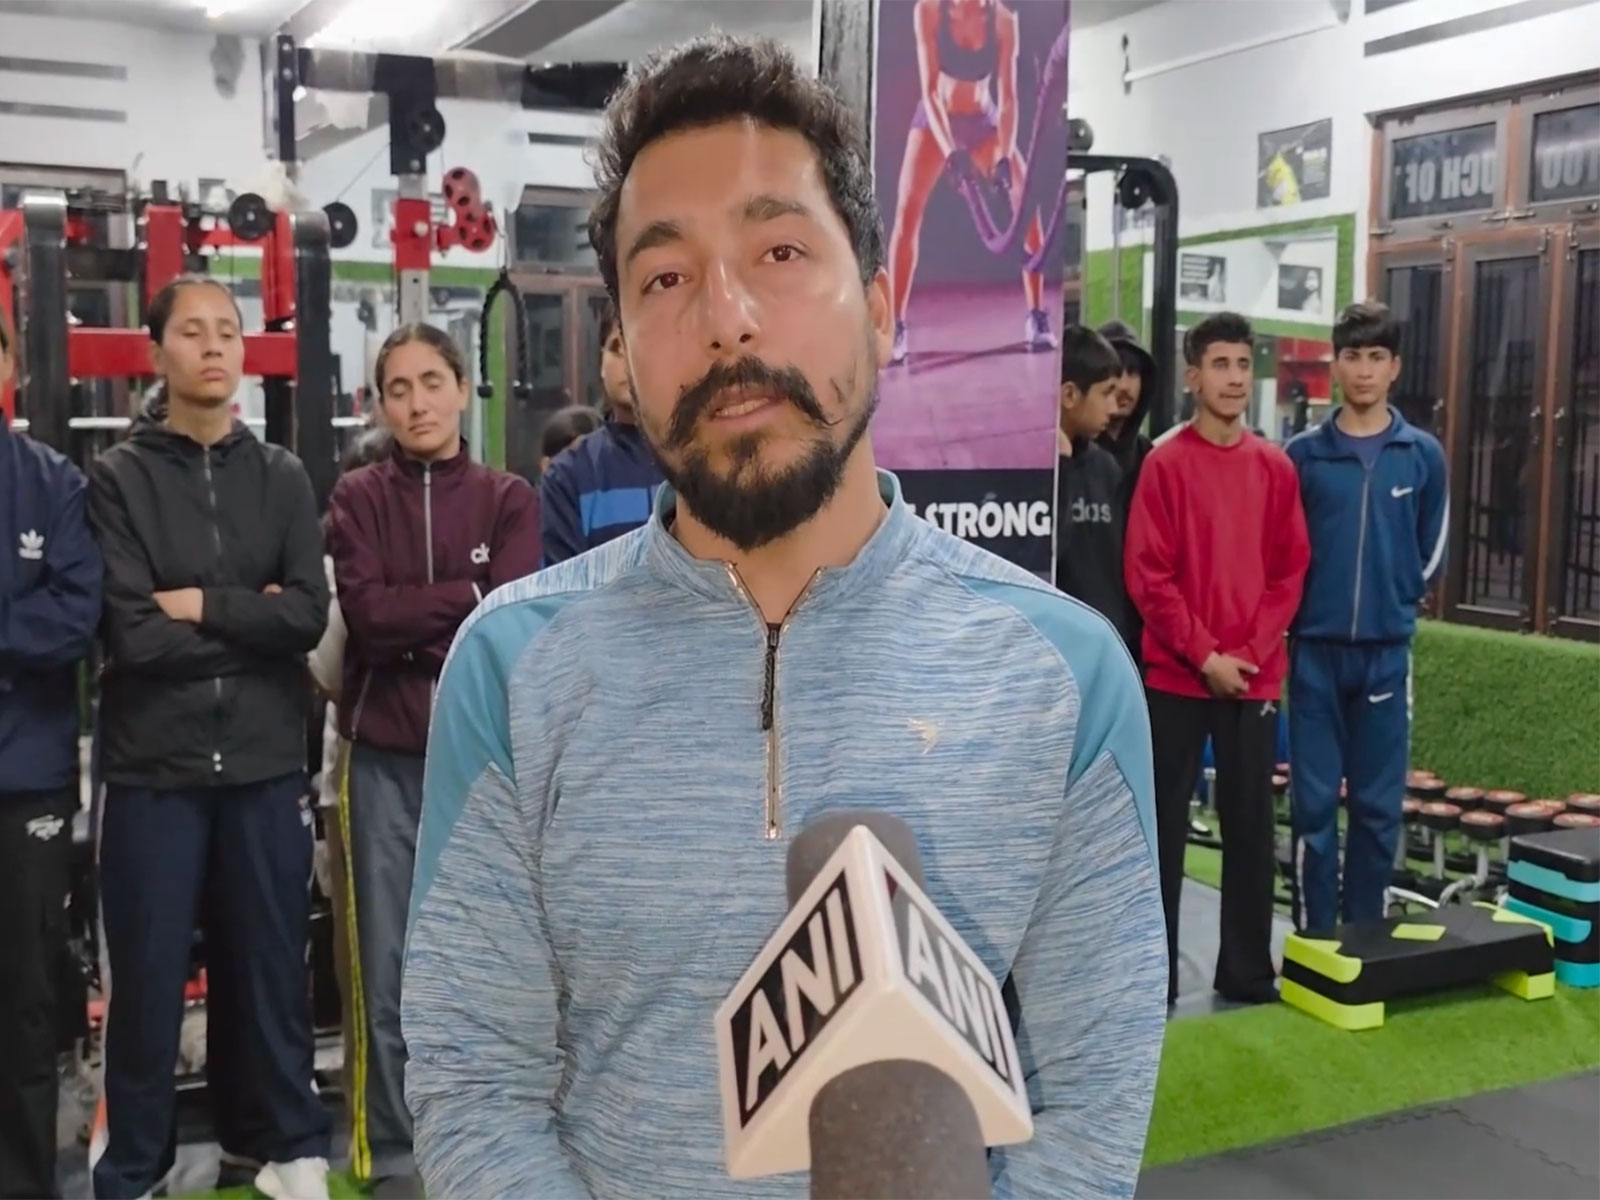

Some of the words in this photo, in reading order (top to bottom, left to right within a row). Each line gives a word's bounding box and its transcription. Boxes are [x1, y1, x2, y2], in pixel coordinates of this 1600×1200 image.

[924, 501, 1051, 538] STRONG
[745, 886, 855, 1112] ANI
[907, 902, 1010, 1087] ANI
